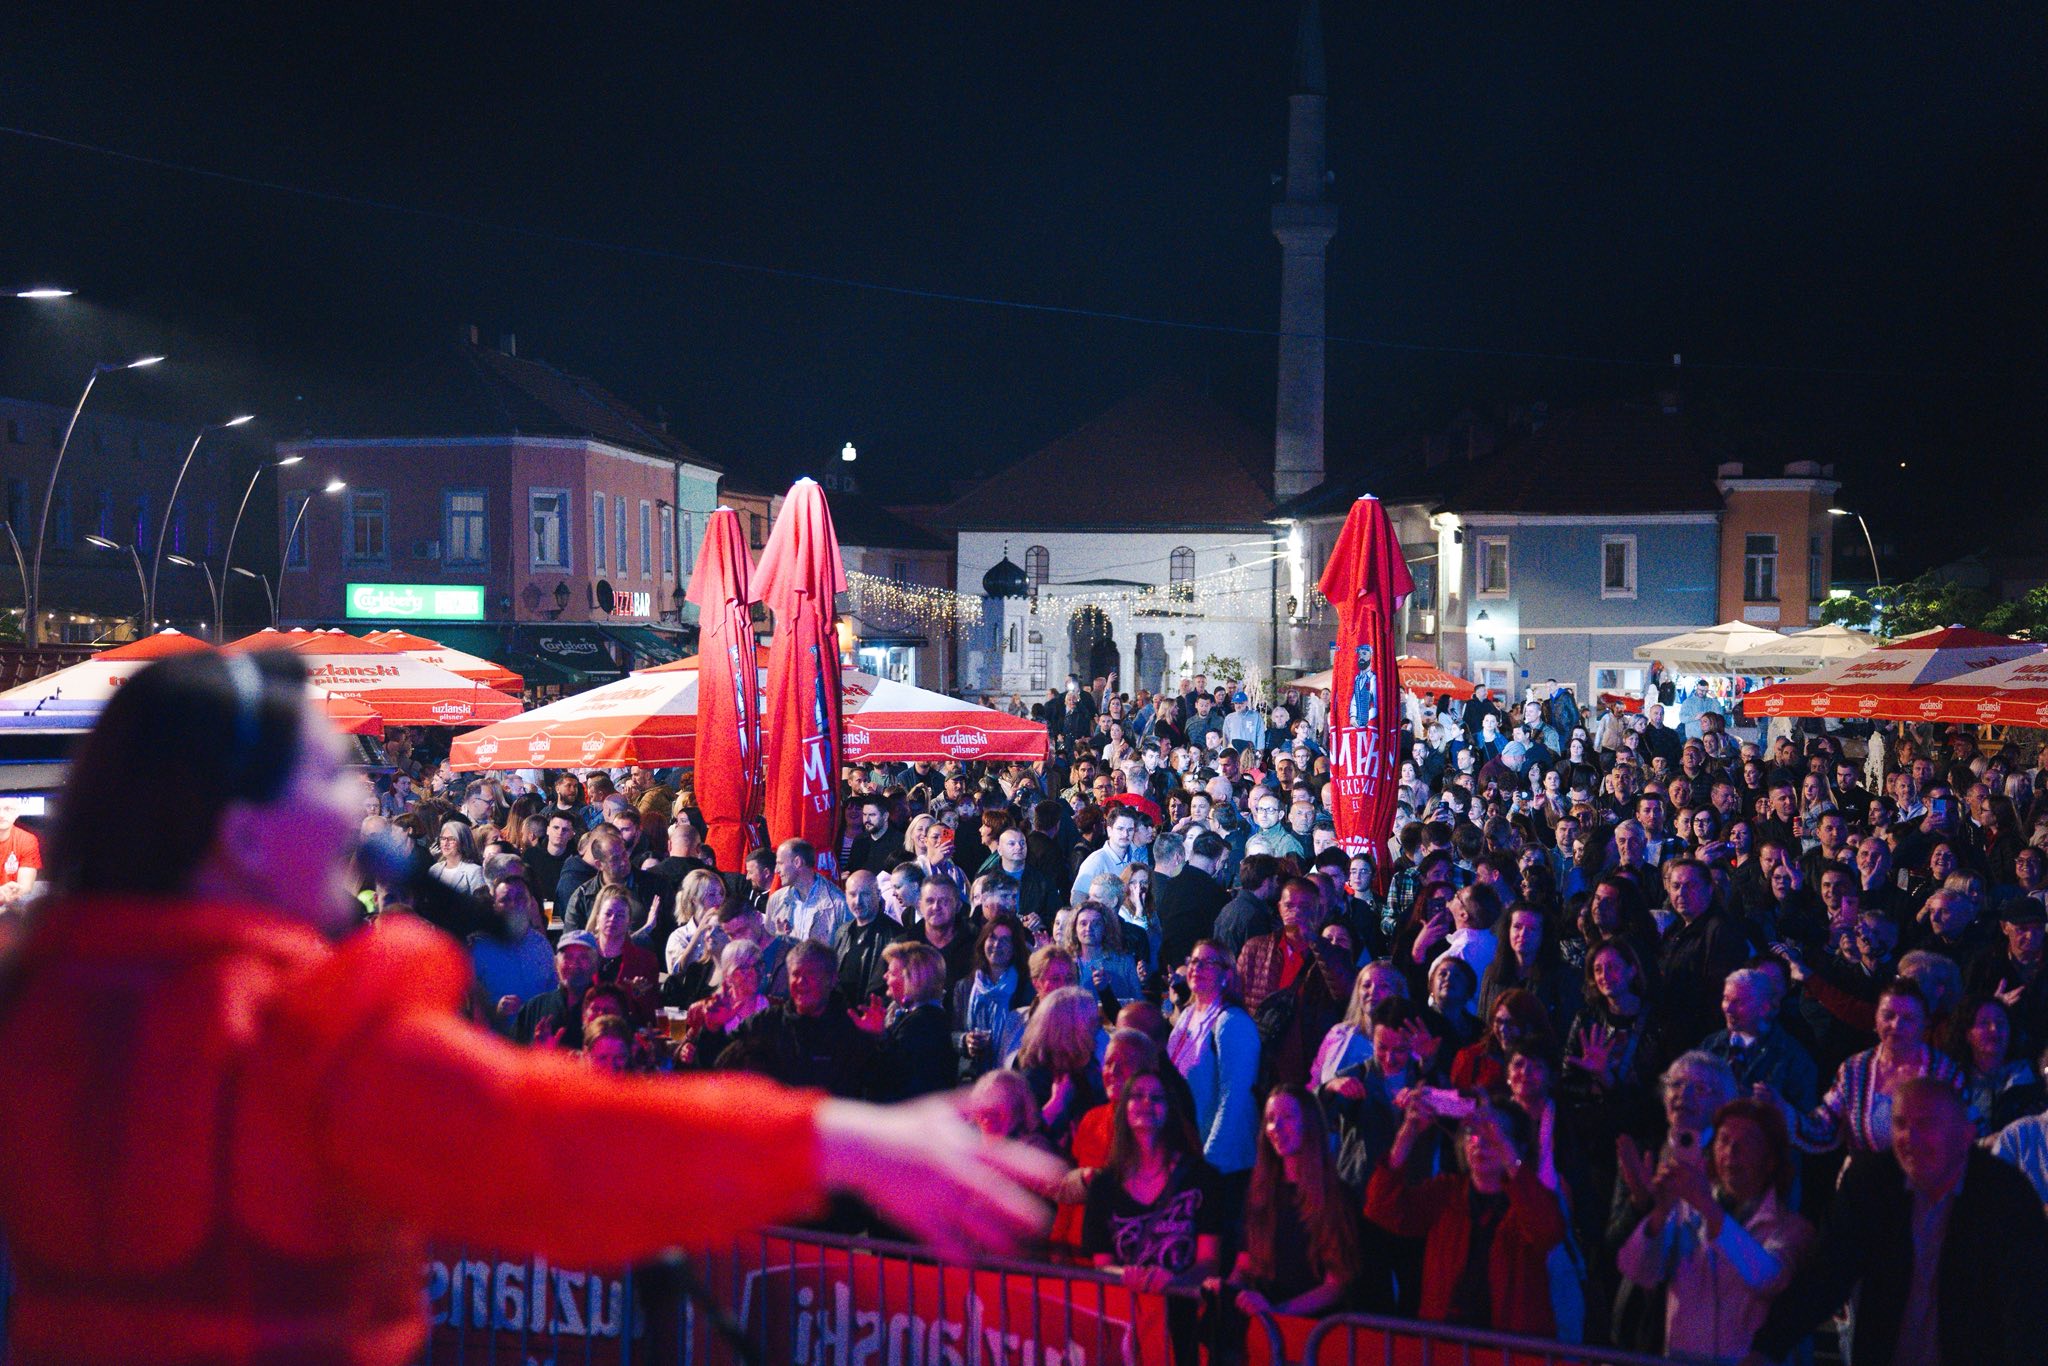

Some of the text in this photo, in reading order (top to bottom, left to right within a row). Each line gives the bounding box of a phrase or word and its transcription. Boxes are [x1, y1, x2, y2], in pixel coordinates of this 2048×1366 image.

[539, 637, 599, 656] Carlsberg
[432, 702, 471, 714] tuzlanski
[941, 729, 988, 745] tuzlanski
[951, 745, 980, 756] pilsner
